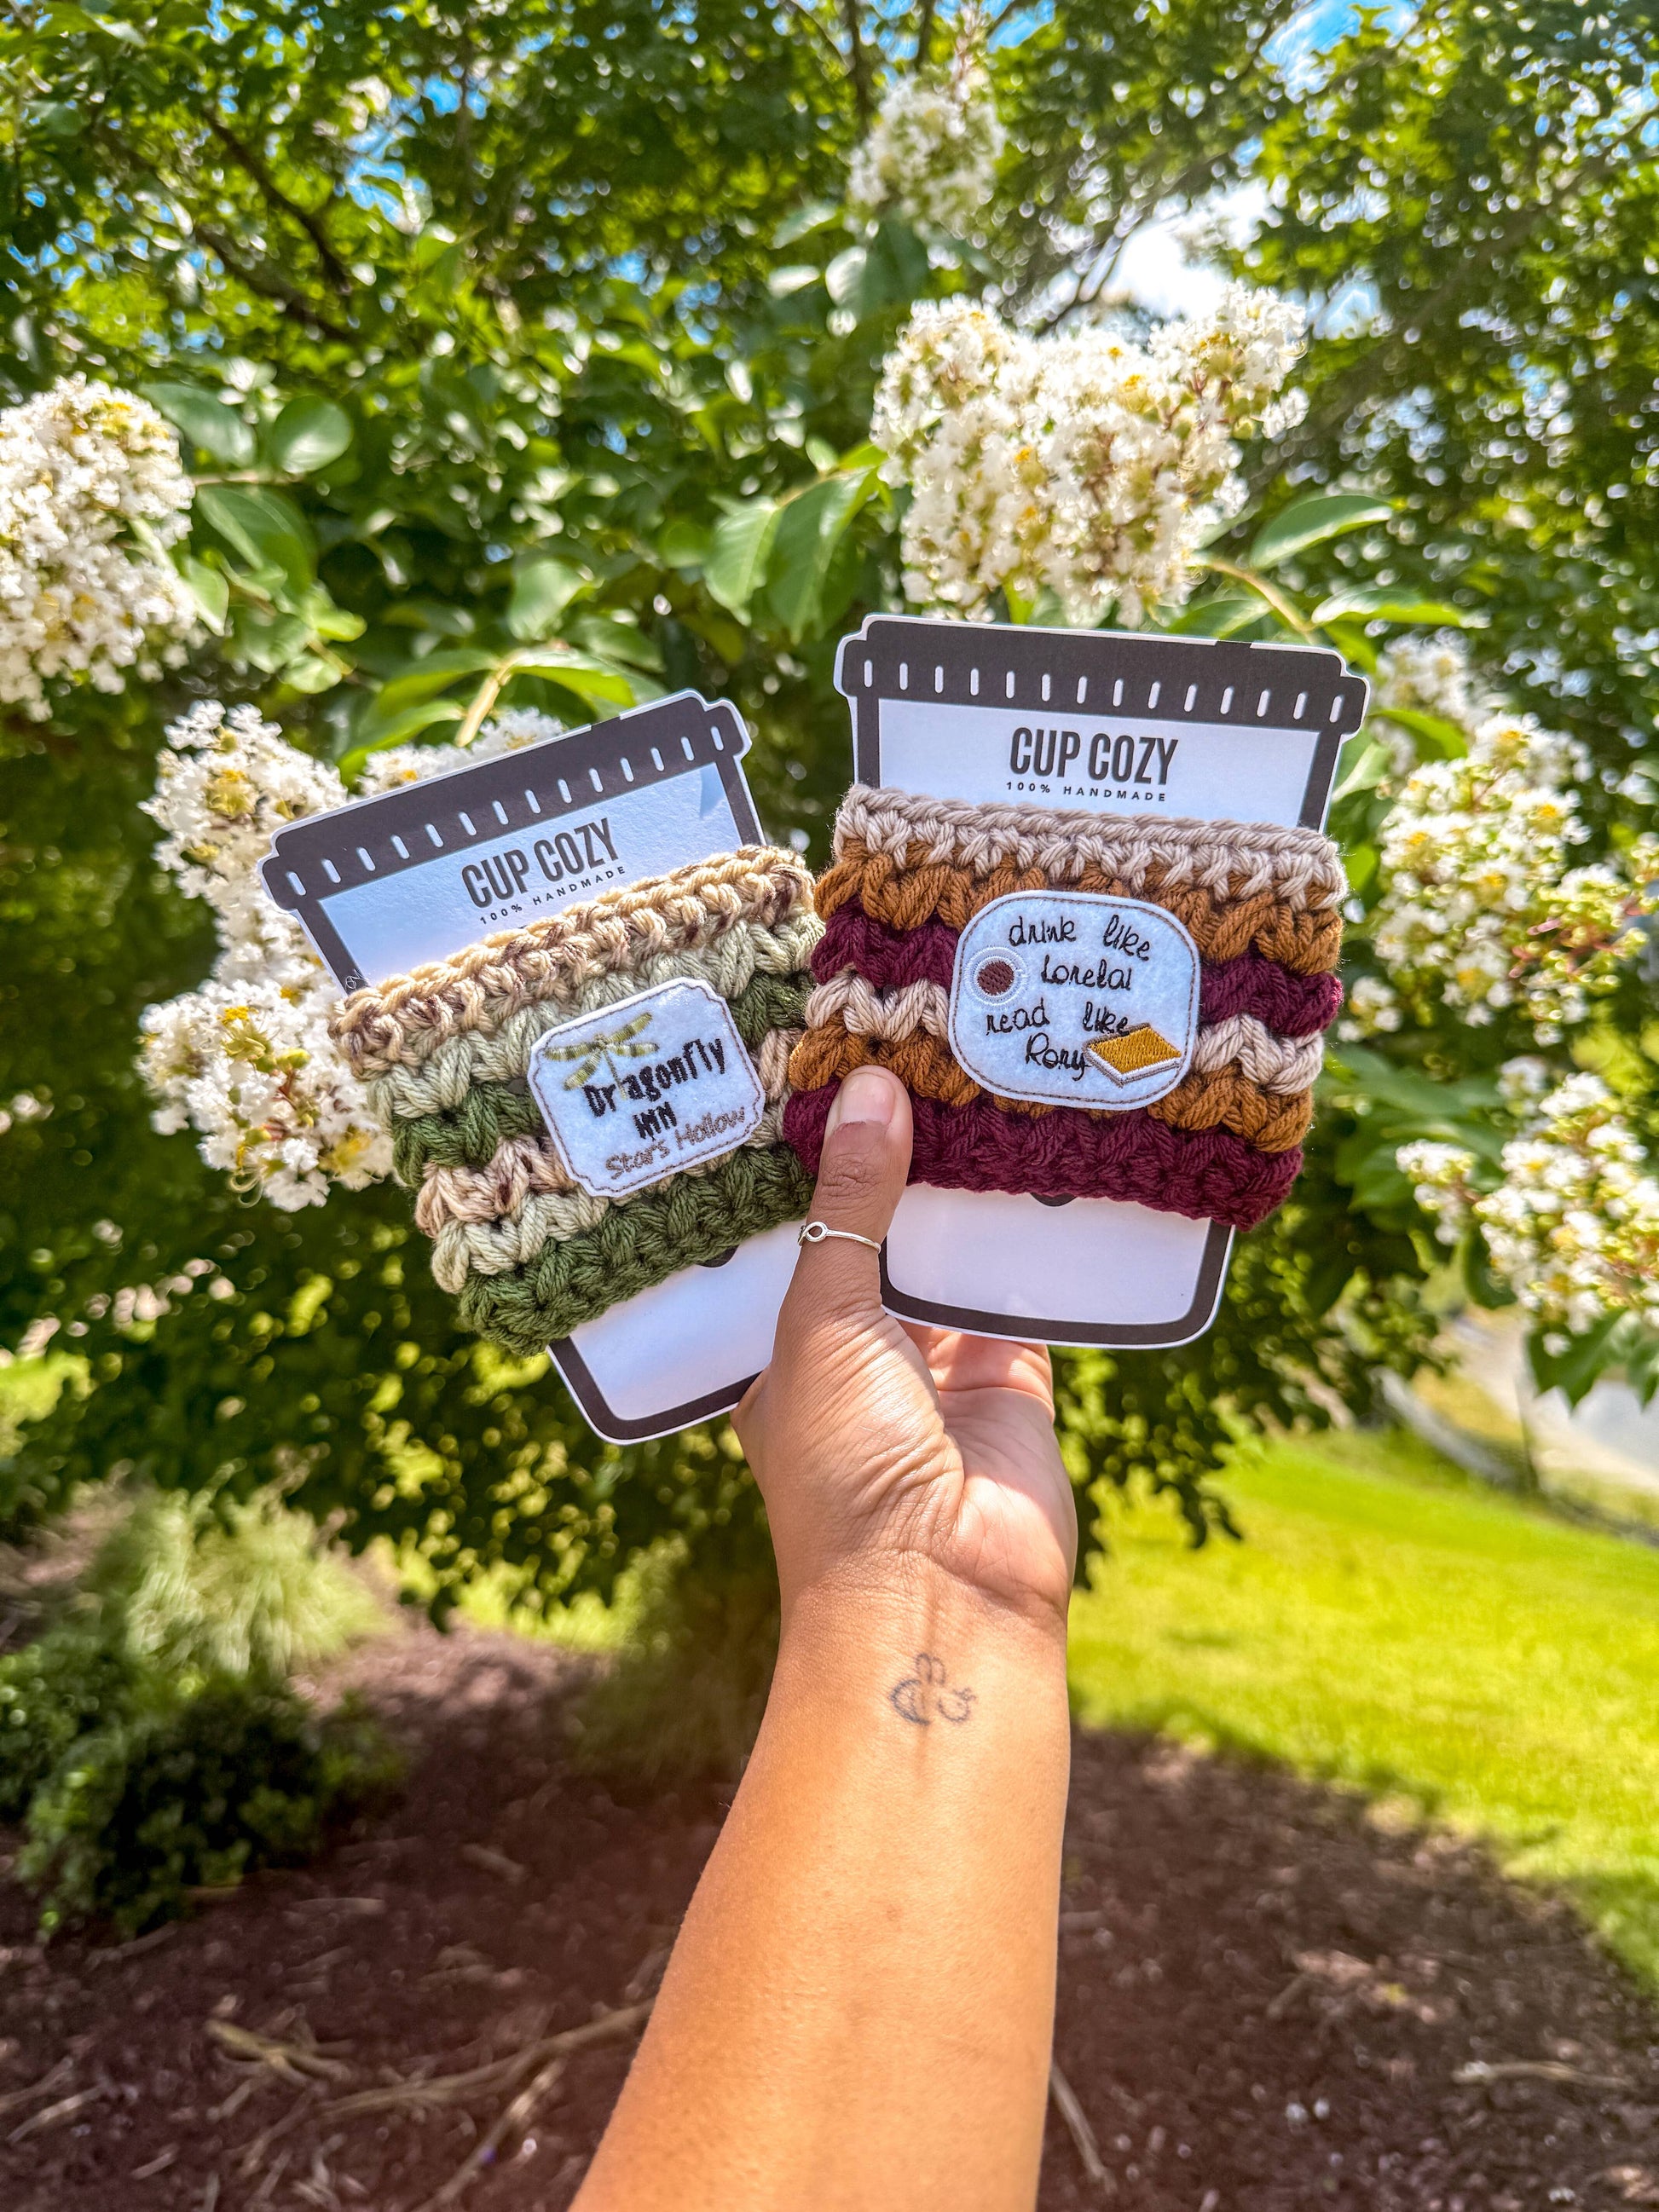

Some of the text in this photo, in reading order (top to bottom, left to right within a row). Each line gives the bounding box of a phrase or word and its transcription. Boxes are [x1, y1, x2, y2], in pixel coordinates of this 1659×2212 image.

[1009, 726, 1179, 786] CUP COZY
[1006, 781, 1166, 802] 100% HANDMADE
[461, 817, 619, 909] CUP COZY
[480, 866, 626, 925] 100% HANDMADE
[1009, 914, 1151, 962] drink like
[986, 997, 1130, 1037] read like
[582, 1038, 725, 1117] Dragonfly
[1026, 1032, 1091, 1081] Rory
[605, 1106, 746, 1180] Stars Hollow
